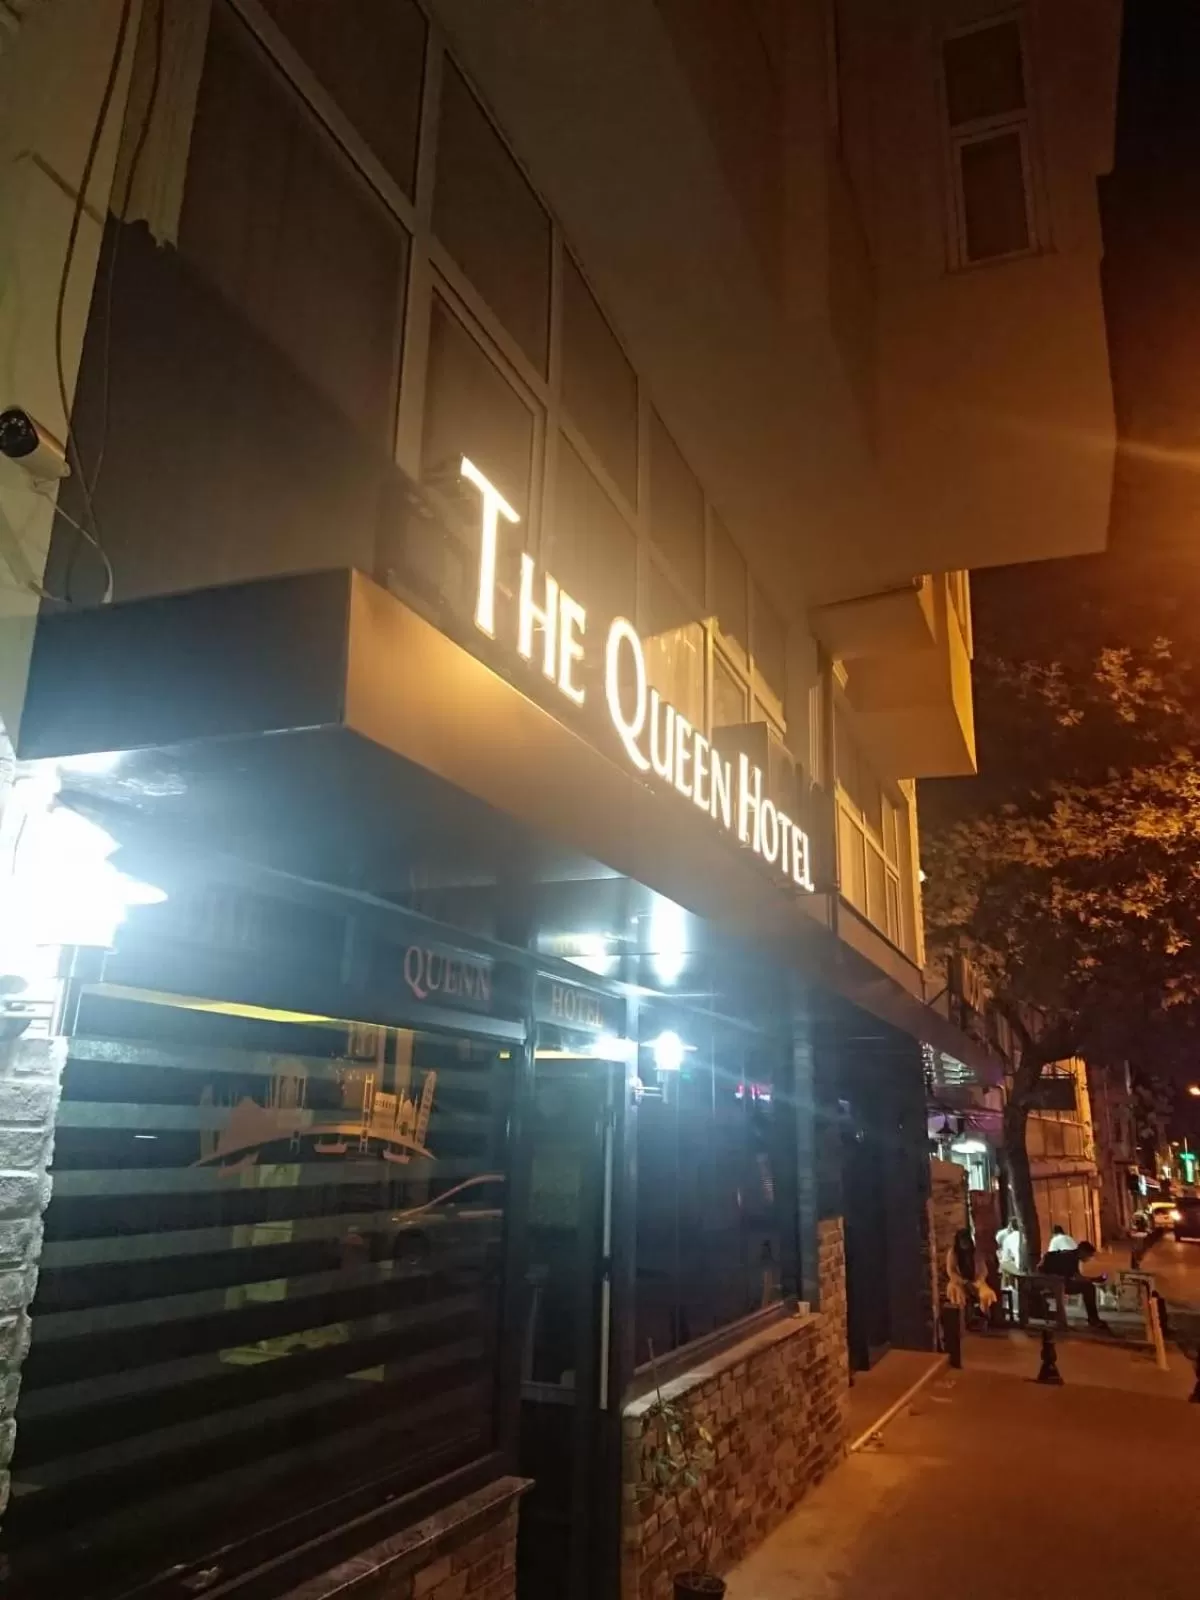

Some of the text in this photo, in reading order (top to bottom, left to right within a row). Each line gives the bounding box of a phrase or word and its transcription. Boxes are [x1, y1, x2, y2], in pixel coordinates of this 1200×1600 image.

[460, 454, 815, 892] THE QUEEN HOTEL
[550, 984, 604, 1028] HOTEL
